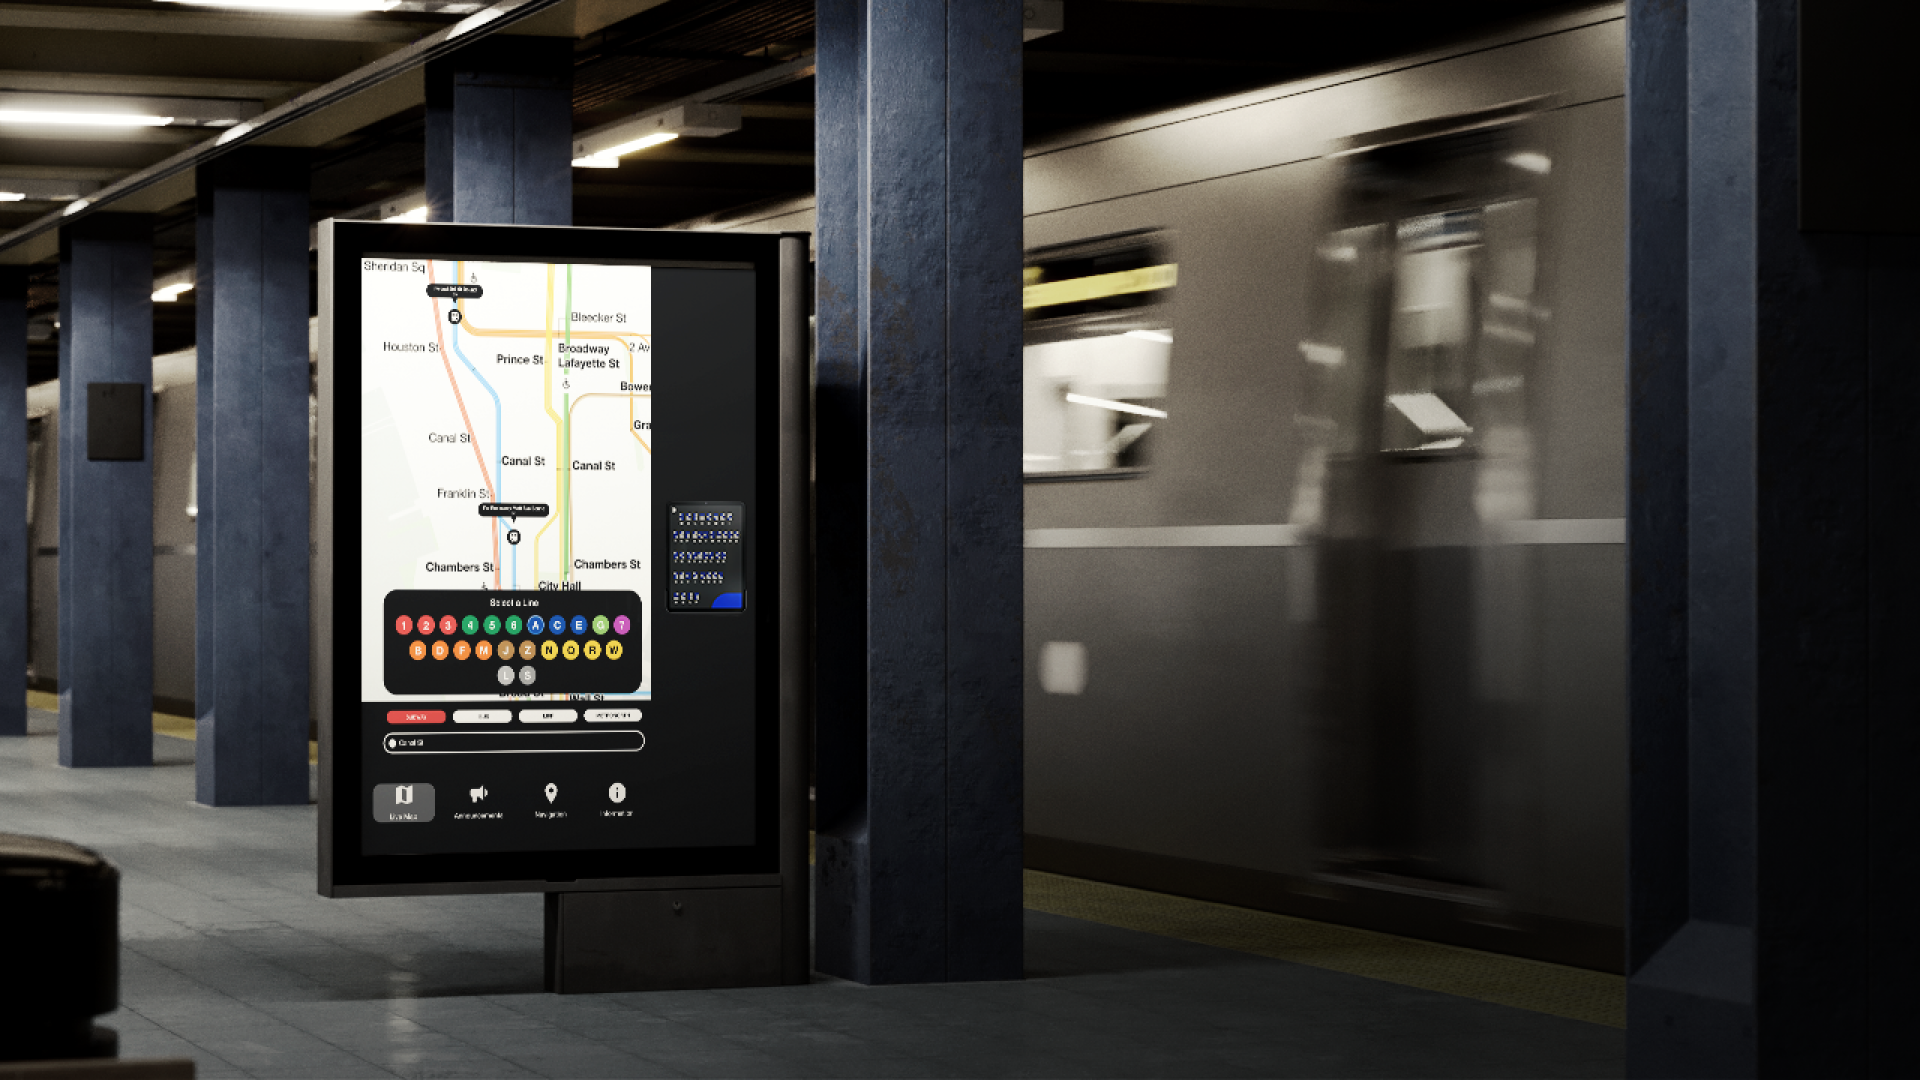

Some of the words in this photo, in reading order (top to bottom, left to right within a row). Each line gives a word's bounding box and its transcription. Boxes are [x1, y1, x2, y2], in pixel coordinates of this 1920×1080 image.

[364, 260, 408, 272] Sheridan
[411, 261, 426, 274] Sq
[571, 311, 613, 323] Bleecker
[615, 312, 627, 324] St
[383, 341, 425, 352] Houston
[428, 342, 440, 353] St
[558, 343, 610, 356] Broadway
[629, 341, 635, 351] 2
[637, 342, 650, 353] Av
[496, 353, 530, 366] Prince
[532, 354, 544, 366] St
[558, 357, 606, 370] Lafayette
[608, 358, 620, 370] St
[428, 432, 457, 444] Canal
[459, 432, 471, 443] St
[501, 455, 532, 467] Canal
[534, 455, 546, 467] St
[572, 460, 602, 472] Canal
[604, 461, 616, 472] St
[437, 487, 477, 499] Franklin
[479, 488, 490, 499] St
[425, 561, 481, 573] Chambers
[482, 562, 495, 573] St
[574, 558, 627, 570] Chambers
[629, 559, 641, 570] St
[538, 580, 559, 591] City
[562, 581, 582, 591] Hall
[489, 598, 514, 607] Select
[522, 599, 540, 607] Line
